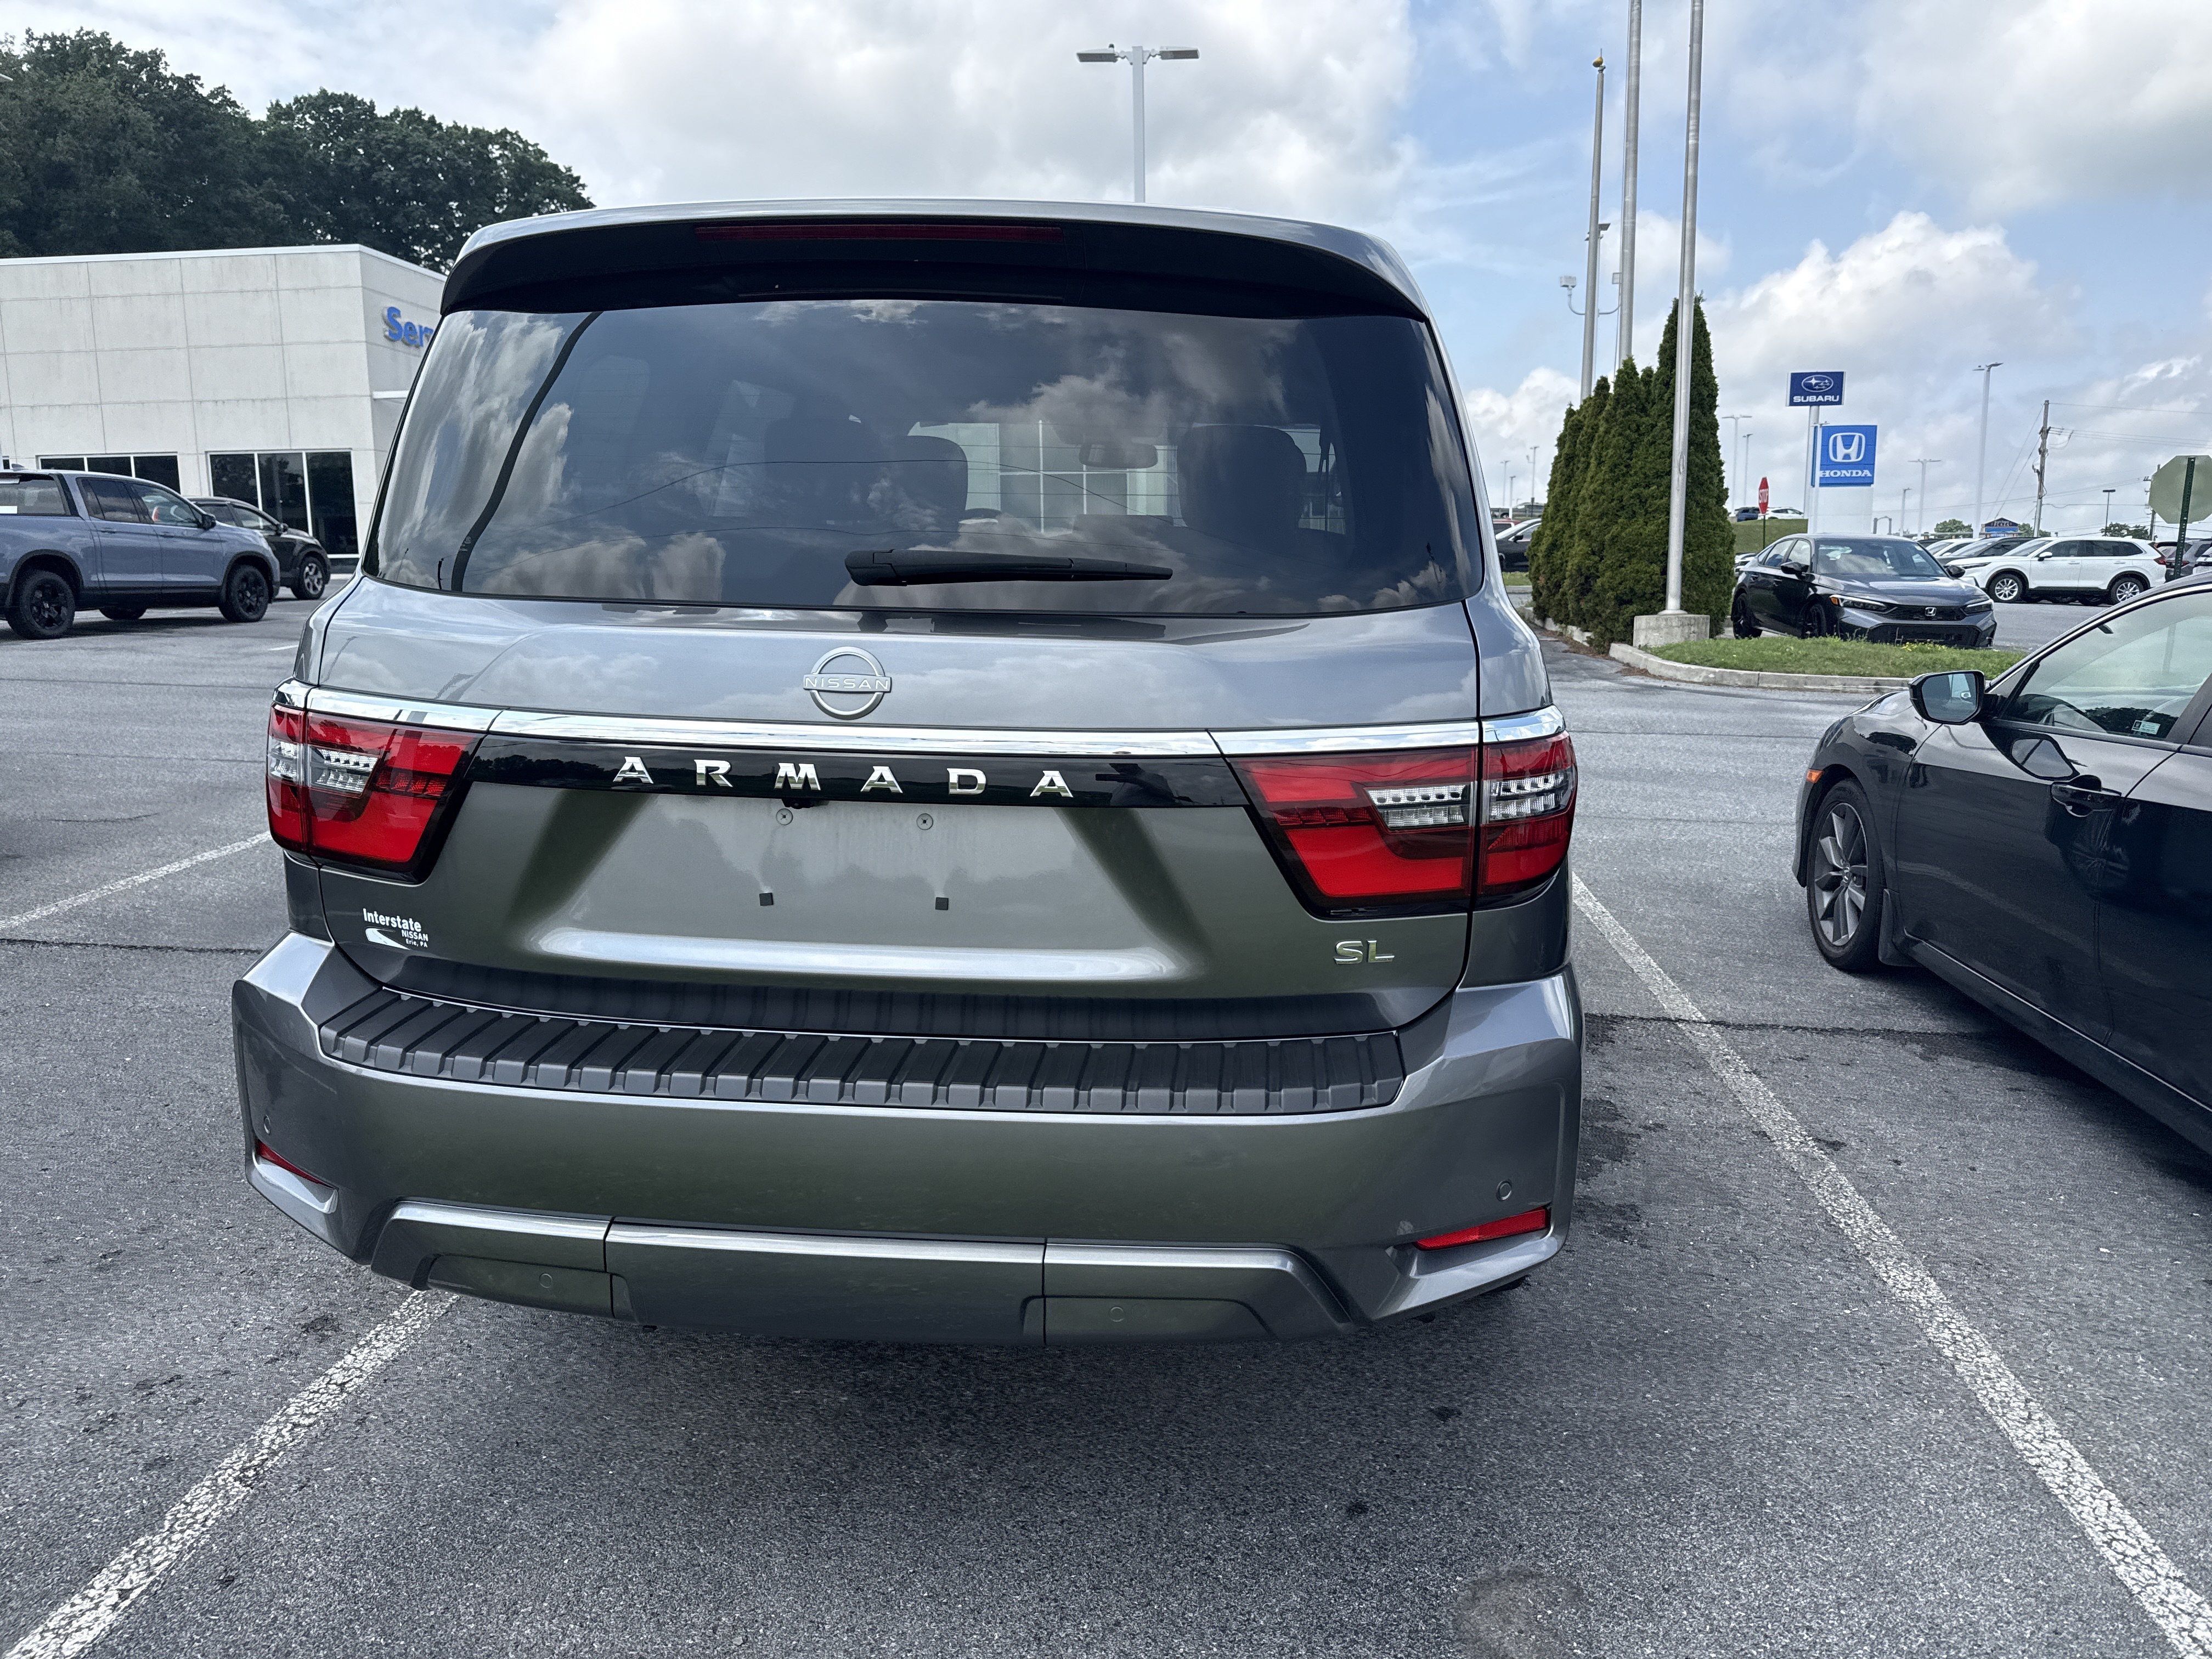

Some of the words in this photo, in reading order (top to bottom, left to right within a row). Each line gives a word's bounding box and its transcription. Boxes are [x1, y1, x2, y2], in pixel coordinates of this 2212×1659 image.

[387, 307, 434, 347] Ser
[1819, 470, 1872, 478] HONDA
[1759, 489, 1768, 503] STOP
[805, 676, 889, 690] NISSAN
[612, 756, 1074, 798] ARMADA
[363, 908, 422, 932] Interstate
[401, 929, 428, 941] NISSAN
[1334, 939, 1395, 965] SL
